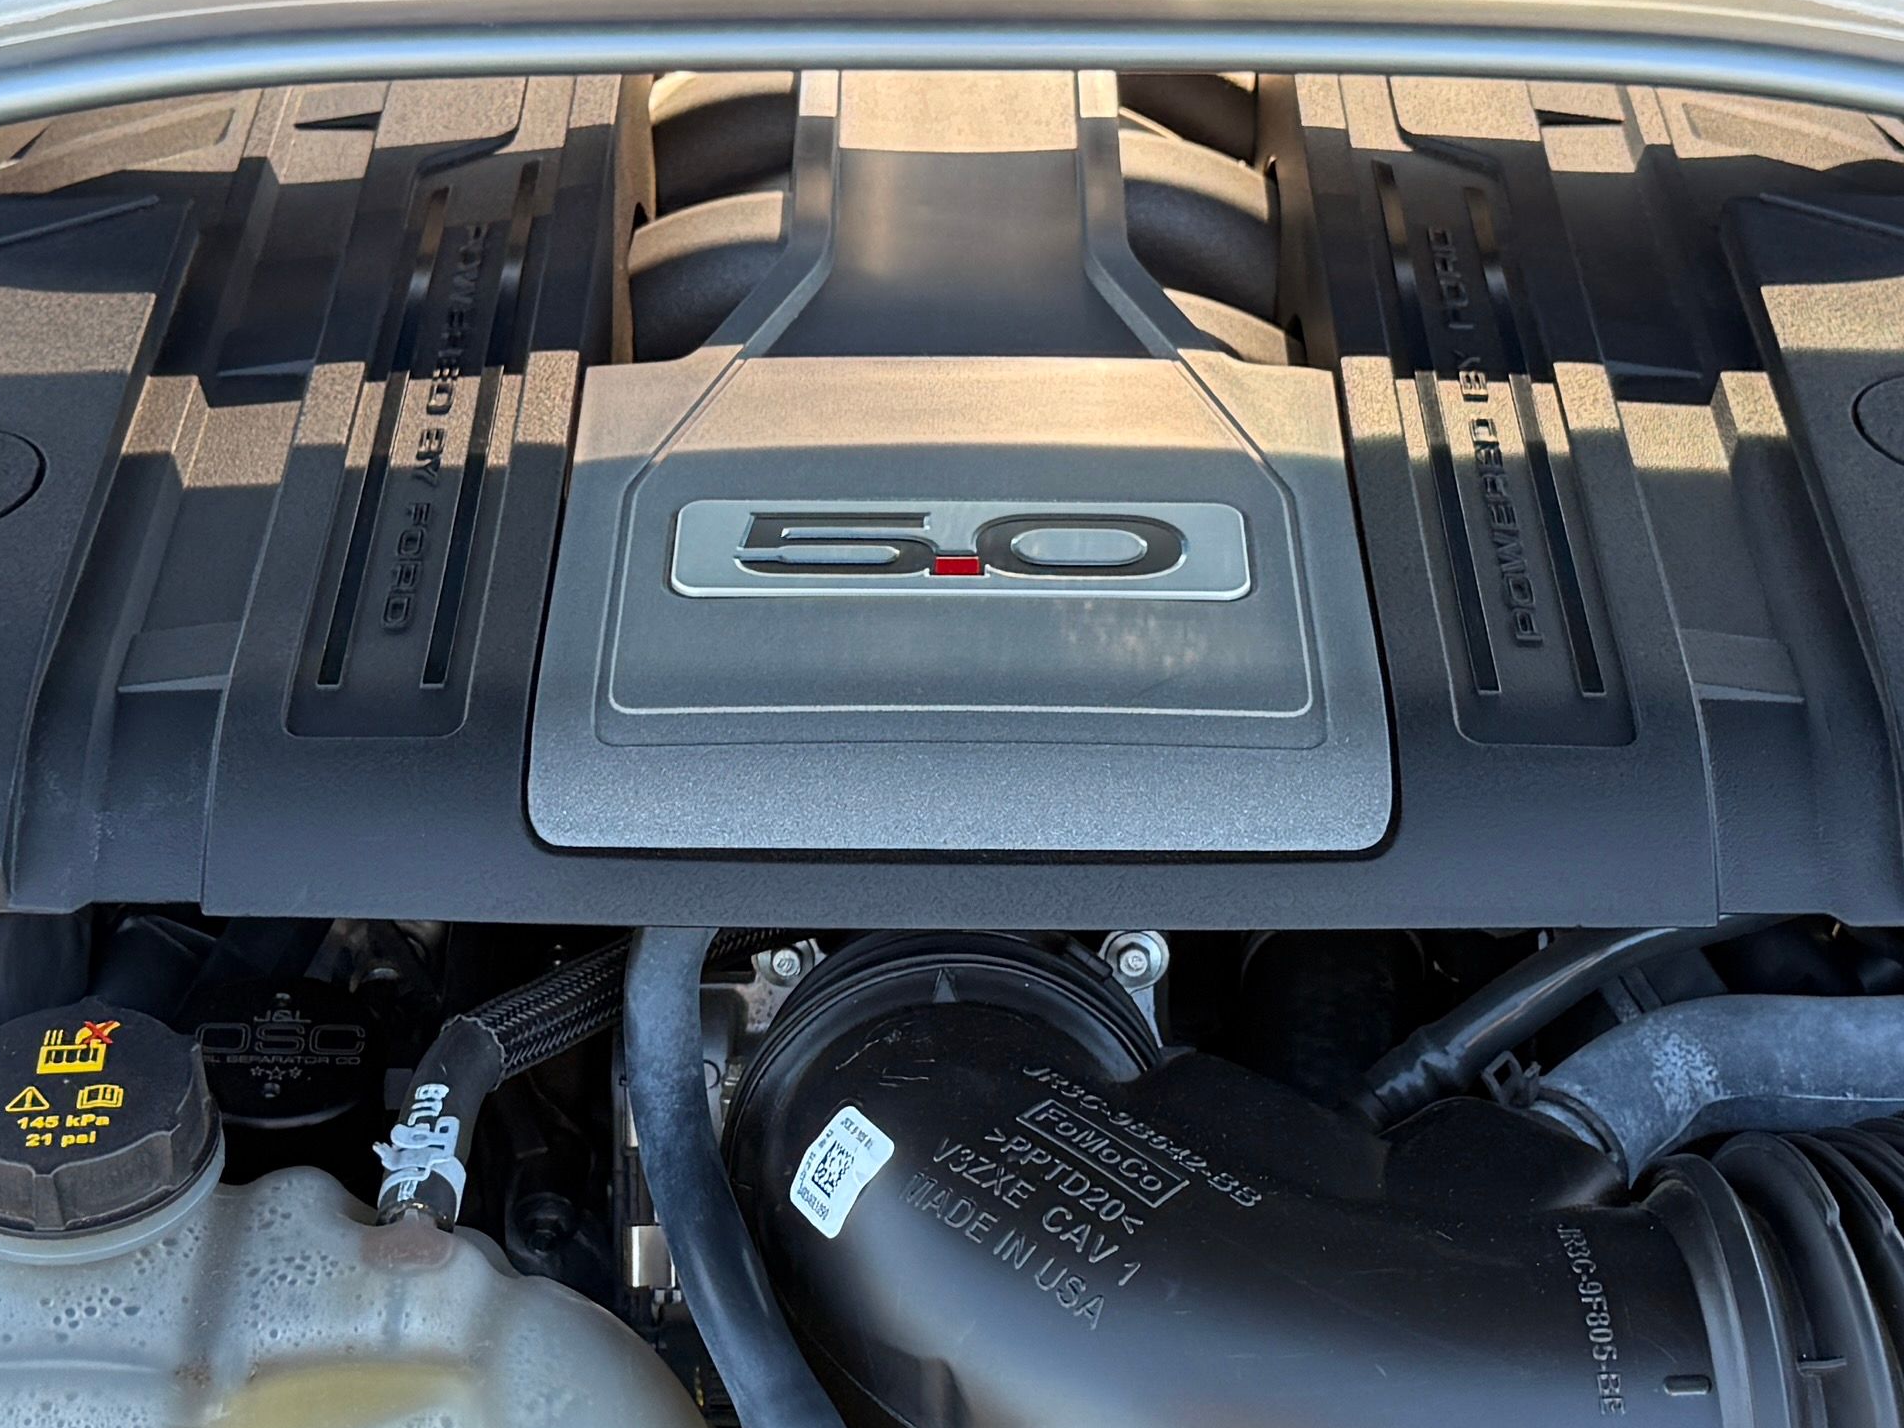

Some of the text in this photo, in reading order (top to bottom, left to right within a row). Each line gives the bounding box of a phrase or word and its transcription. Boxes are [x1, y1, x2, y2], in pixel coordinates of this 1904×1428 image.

[1456, 349, 1490, 403] BY
[412, 426, 447, 489] BY
[732, 511, 1188, 578] 5.0
[1468, 417, 1546, 649] POWERED
[381, 501, 432, 634] FORD
[196, 1022, 367, 1055] OSC
[226, 1054, 331, 1065] SEPARATOR
[16, 1113, 110, 1130] 145 kPa
[25, 1130, 97, 1148] 21 psi
[1034, 1107, 1164, 1193] FoMoCo
[899, 1171, 999, 1245] MADE
[992, 1227, 1039, 1271] IN
[1033, 1257, 1106, 1331] USA
[1041, 1206, 1120, 1264] CAV
[1117, 1261, 1142, 1287] 1
